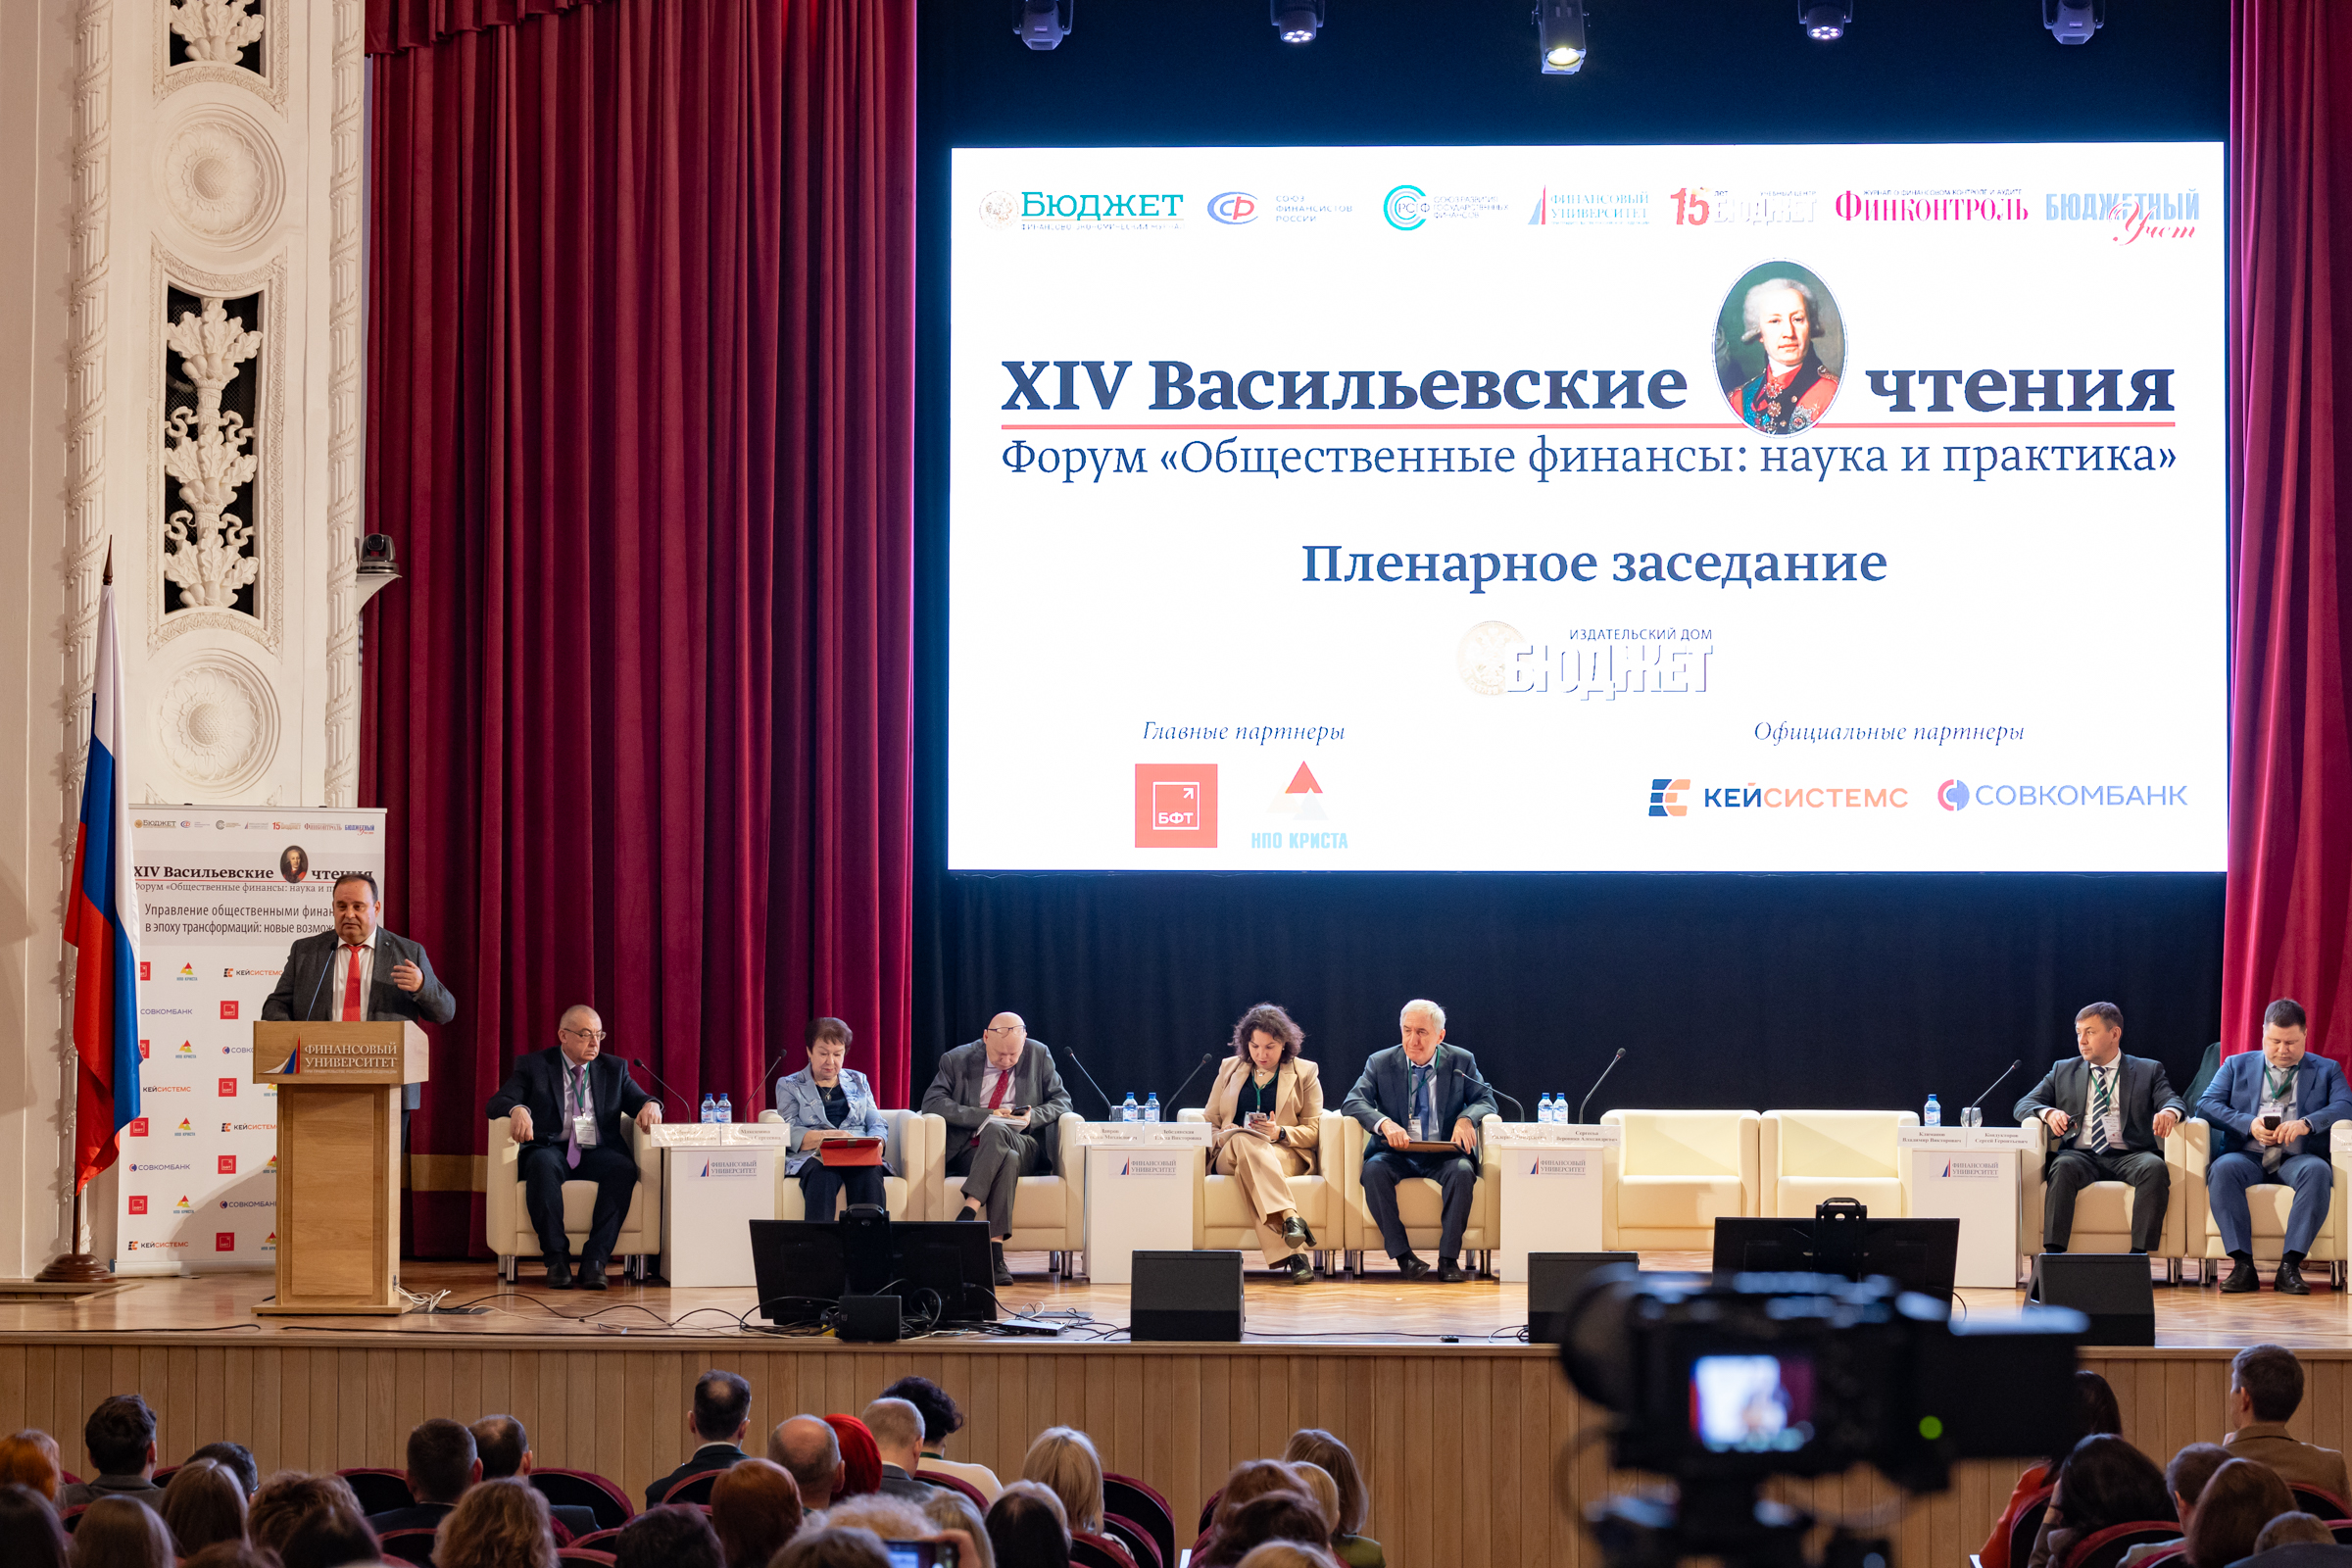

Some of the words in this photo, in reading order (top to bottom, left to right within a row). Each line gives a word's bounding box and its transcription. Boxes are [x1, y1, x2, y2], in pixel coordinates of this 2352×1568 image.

[1670, 186, 1710, 225] 15
[2046, 188, 2199, 220] БЮДЖЕТНЫЙ
[1002, 361, 1133, 410] XIV
[1149, 361, 1688, 411] Васильевские
[1865, 368, 2175, 413] чтения
[1003, 440, 1149, 483] Форум
[1160, 435, 1515, 479] «Общественные
[1529, 434, 1746, 483] финансы:
[1760, 446, 1886, 482] наука
[1901, 447, 1931, 471] и
[1942, 446, 2177, 482] практика»
[1302, 546, 1597, 594] Пленарное
[1613, 553, 1887, 589] заседание
[1570, 627, 1676, 642] ИЗДАТЕЛЬСКИЙ
[1681, 629, 1712, 642] ДОМ
[1143, 721, 1228, 740] Главные
[1236, 726, 1345, 746] партнеры
[1754, 720, 1906, 746] Официальные
[1914, 726, 2024, 746] партнеры
[1705, 782, 1908, 808] КЕЙСИСТЕМС
[1976, 785, 2187, 806] СОВКОМБАНК
[1158, 812, 1194, 824] БФТ
[1251, 832, 1282, 849] НПО
[1290, 832, 1348, 849] КРИСТА
[134, 866, 161, 877] XIV
[164, 866, 274, 879] Васильевские
[166, 882, 240, 892] «Общественные
[289, 885, 316, 894] наука
[145, 904, 209, 918] Управление
[212, 904, 299, 917] общественными
[145, 923, 151, 932] в
[153, 923, 181, 936] эпоху
[182, 920, 262, 936] трансформаций:
[264, 924, 294, 933] новые
[304, 1042, 397, 1054] ФИНАНСОВЫЙ
[305, 1057, 397, 1068] УНИВЕРСИТЕТ
